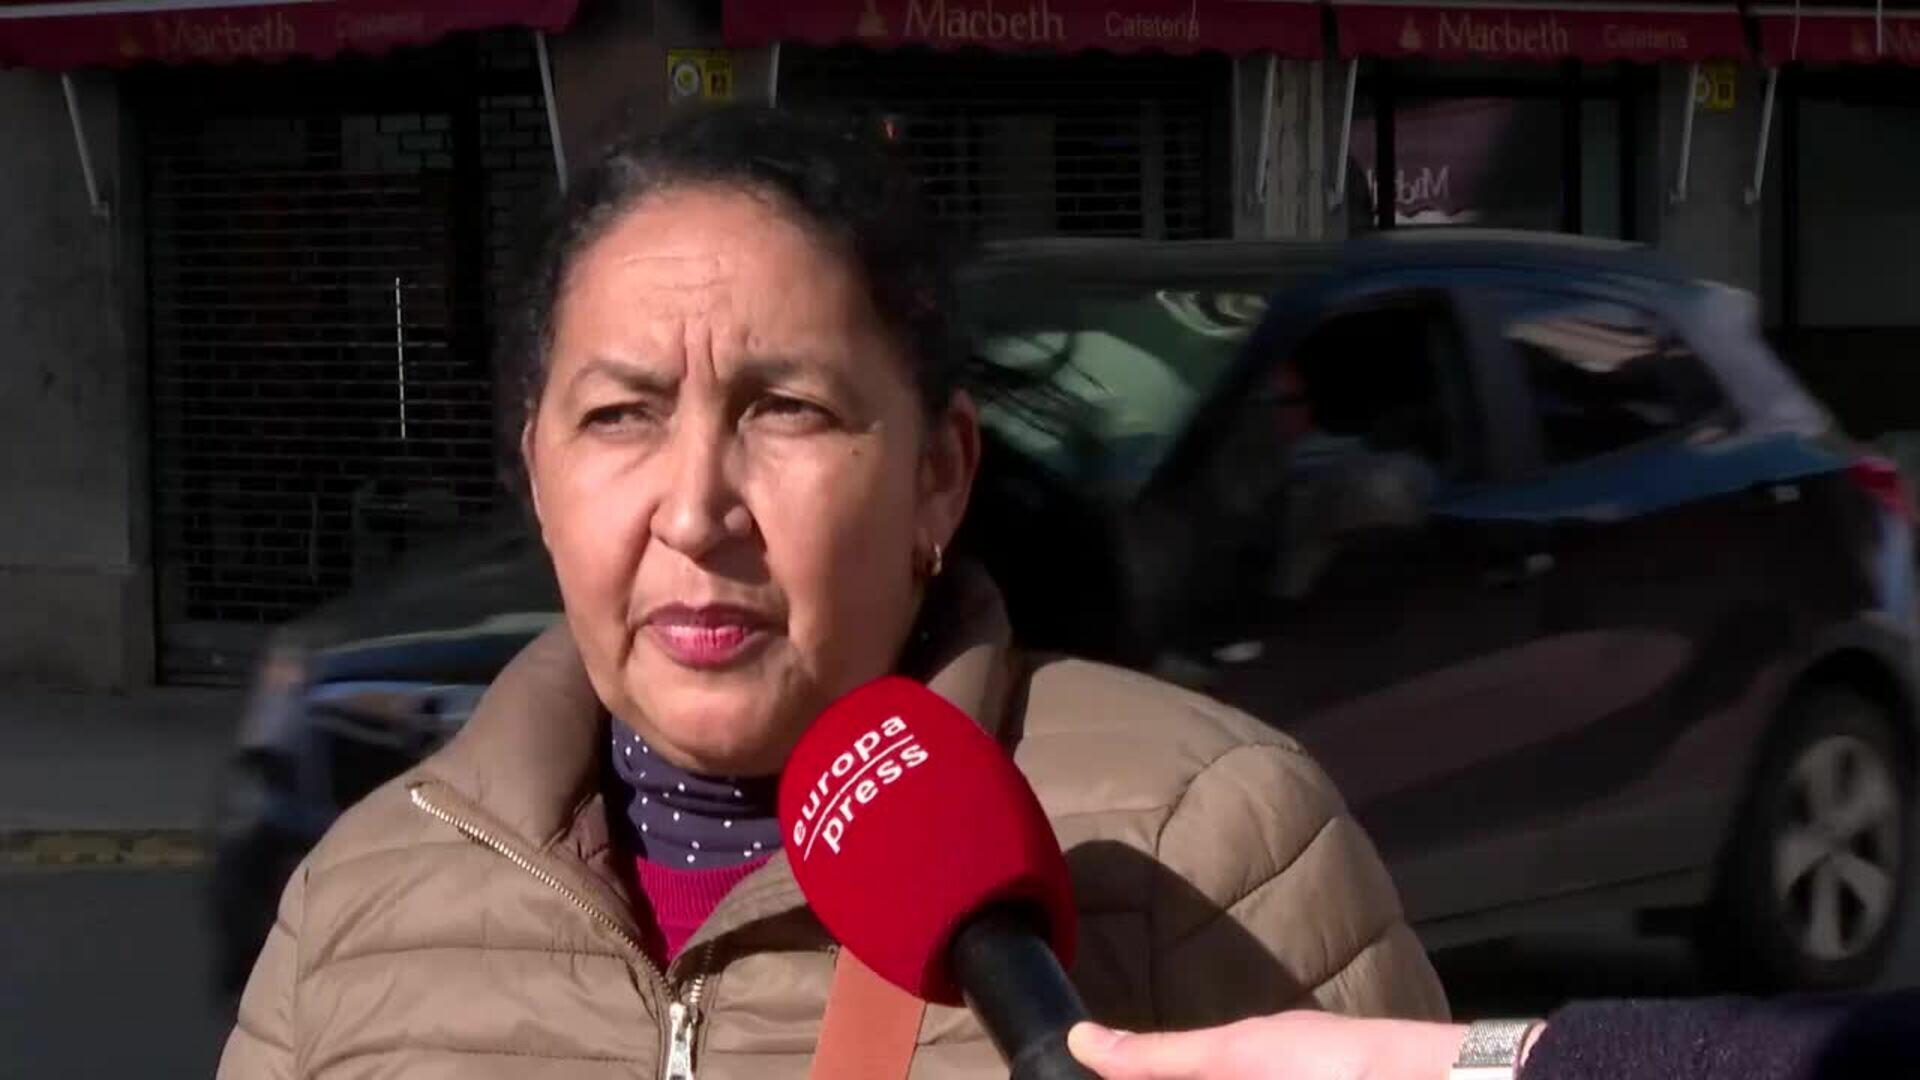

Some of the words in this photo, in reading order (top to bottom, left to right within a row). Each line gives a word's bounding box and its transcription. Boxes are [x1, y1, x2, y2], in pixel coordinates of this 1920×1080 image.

[903, 0, 1067, 40] Macbeth
[1103, 11, 1197, 40] Cafeteria
[1438, 11, 1569, 54] Macbeth
[793, 716, 907, 846] europa
[821, 743, 929, 854] press
